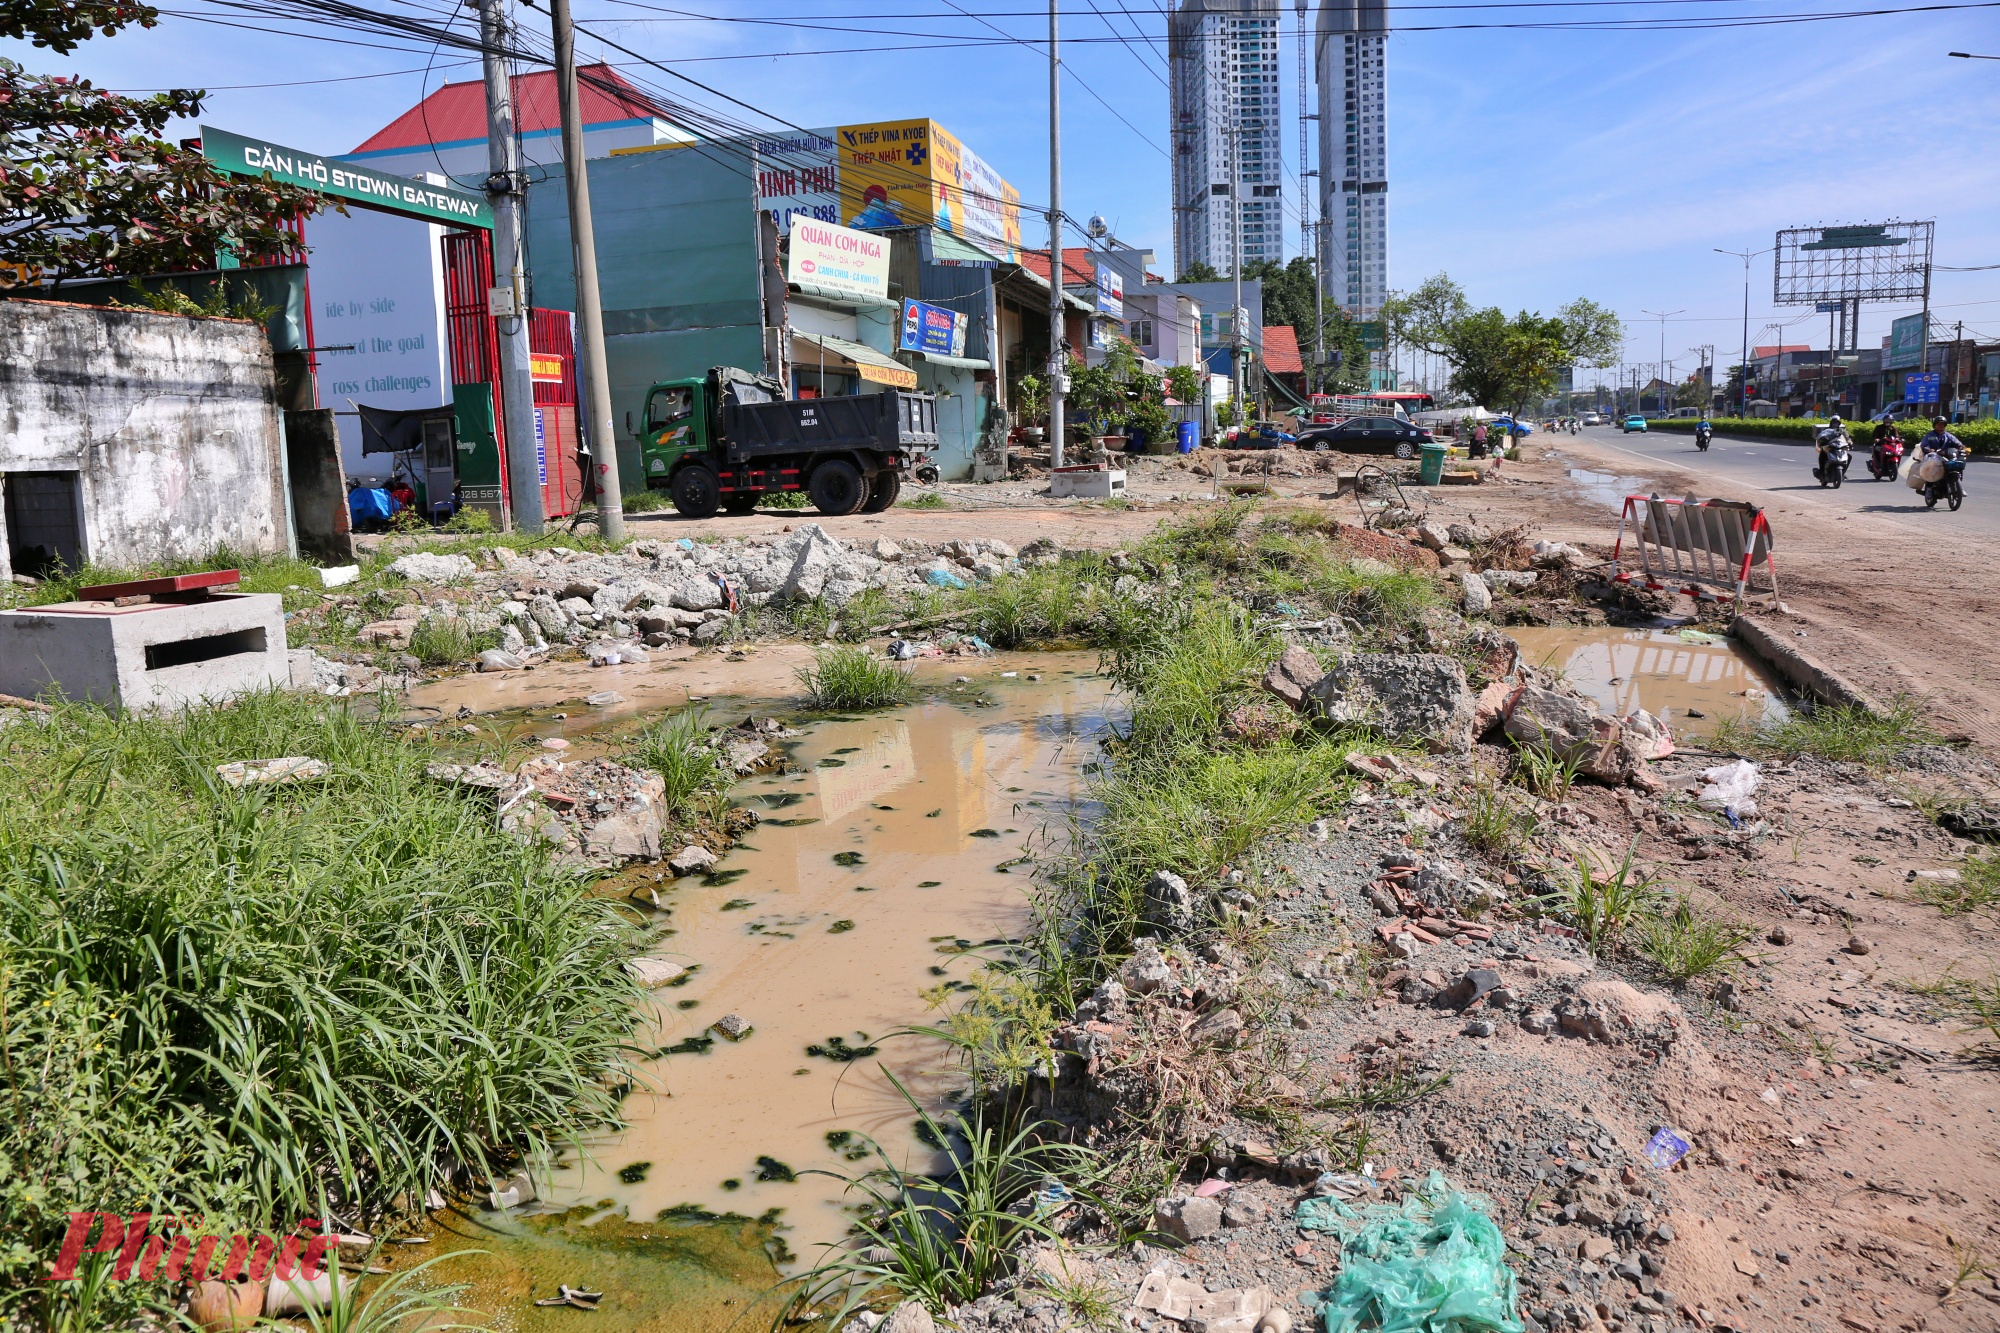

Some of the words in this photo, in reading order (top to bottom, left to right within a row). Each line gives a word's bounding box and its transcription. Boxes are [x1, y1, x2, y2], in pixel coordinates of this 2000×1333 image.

[859, 128, 879, 144] THÉP
[882, 129, 900, 142] VINA
[903, 126, 926, 140] KYOEI
[852, 149, 875, 165] THÉP
[879, 147, 901, 164] NHẬT
[244, 146, 293, 175] CĂN
[297, 159, 328, 188] HỘ
[332, 168, 399, 200] STOWN
[402, 186, 479, 217] GATEWAY
[802, 157, 835, 194] PHÚ
[801, 226, 832, 247] QUÁN
[835, 234, 857, 253] CƠM
[861, 241, 881, 258] NGA
[350, 300, 364, 319] by
[370, 297, 395, 315] side
[371, 337, 392, 353] the
[398, 334, 424, 355] goal
[365, 376, 431, 393] challenges
[888, 368, 910, 384] NGA
